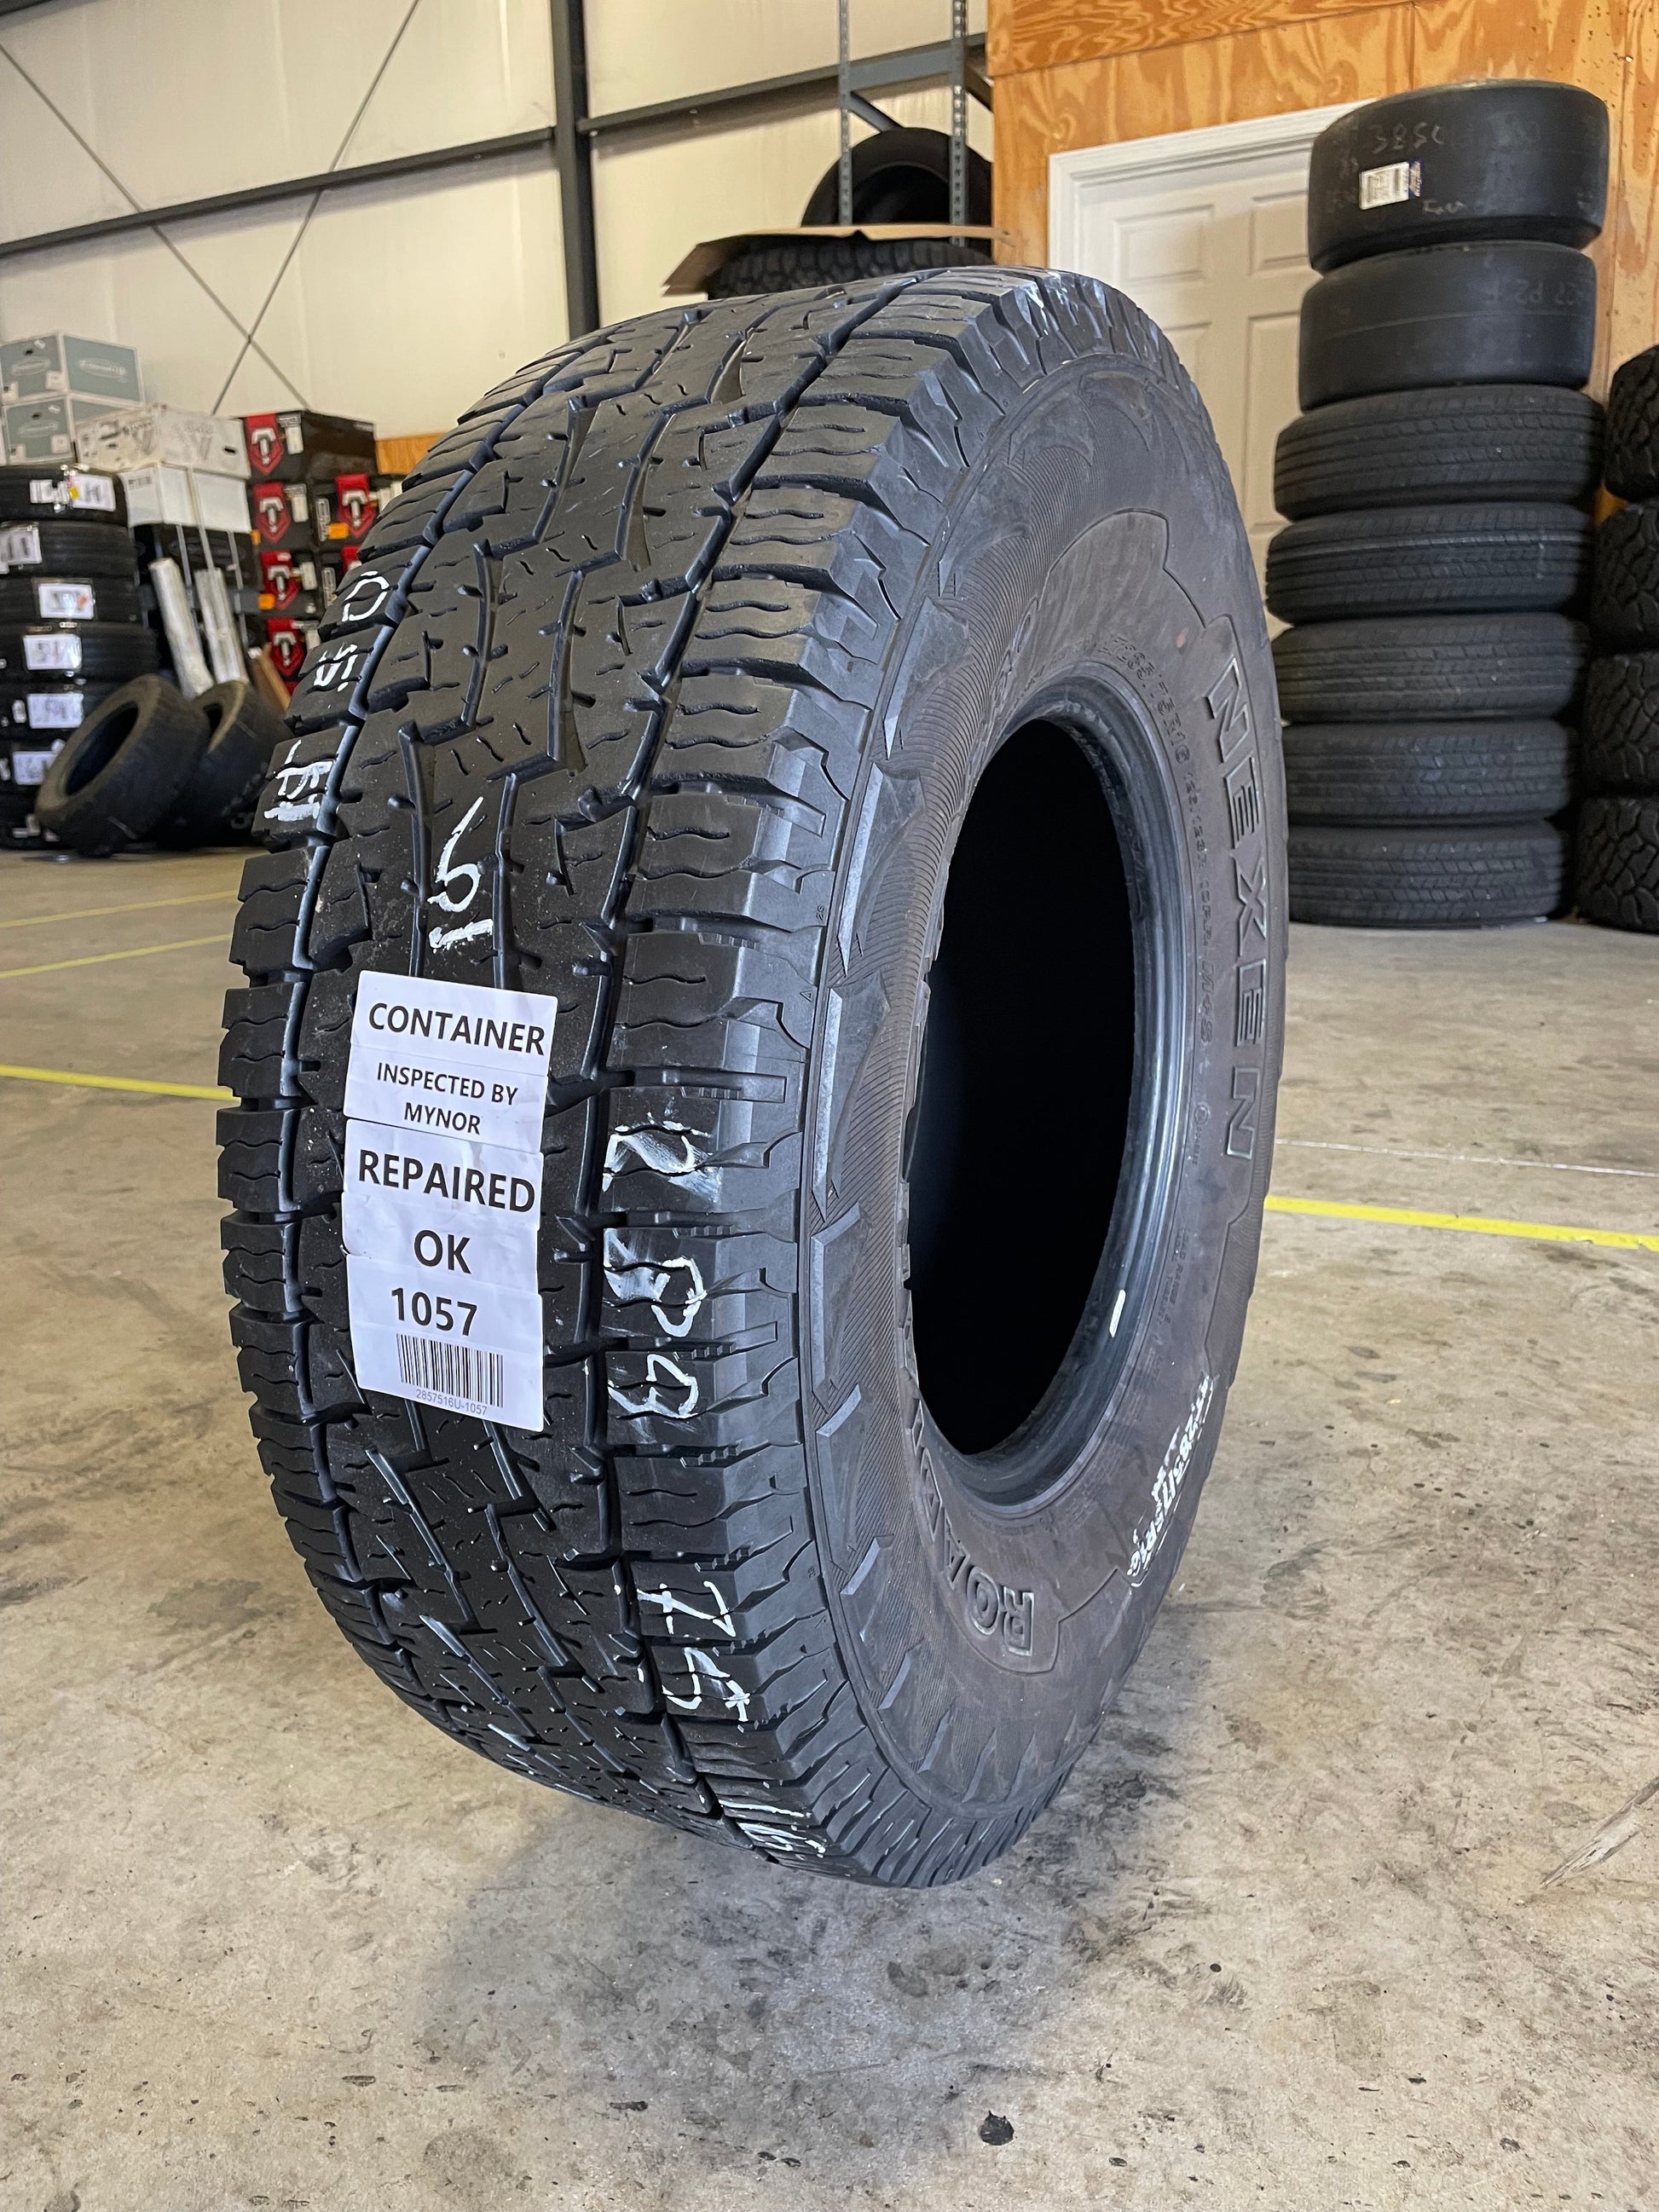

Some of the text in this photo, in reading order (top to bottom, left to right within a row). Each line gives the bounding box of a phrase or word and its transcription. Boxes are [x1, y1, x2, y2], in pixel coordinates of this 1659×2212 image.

[1204, 656, 1268, 1160] NEXEN
[368, 1002, 545, 1056] CONTAINER
[376, 1061, 518, 1106] INSPECTED BY
[403, 1102, 481, 1135] MYNOR
[358, 1148, 535, 1214] REPAIRED
[413, 1230, 471, 1274] OK
[391, 1286, 478, 1337] 1057
[416, 1388, 488, 1417] 2857516U-1057
